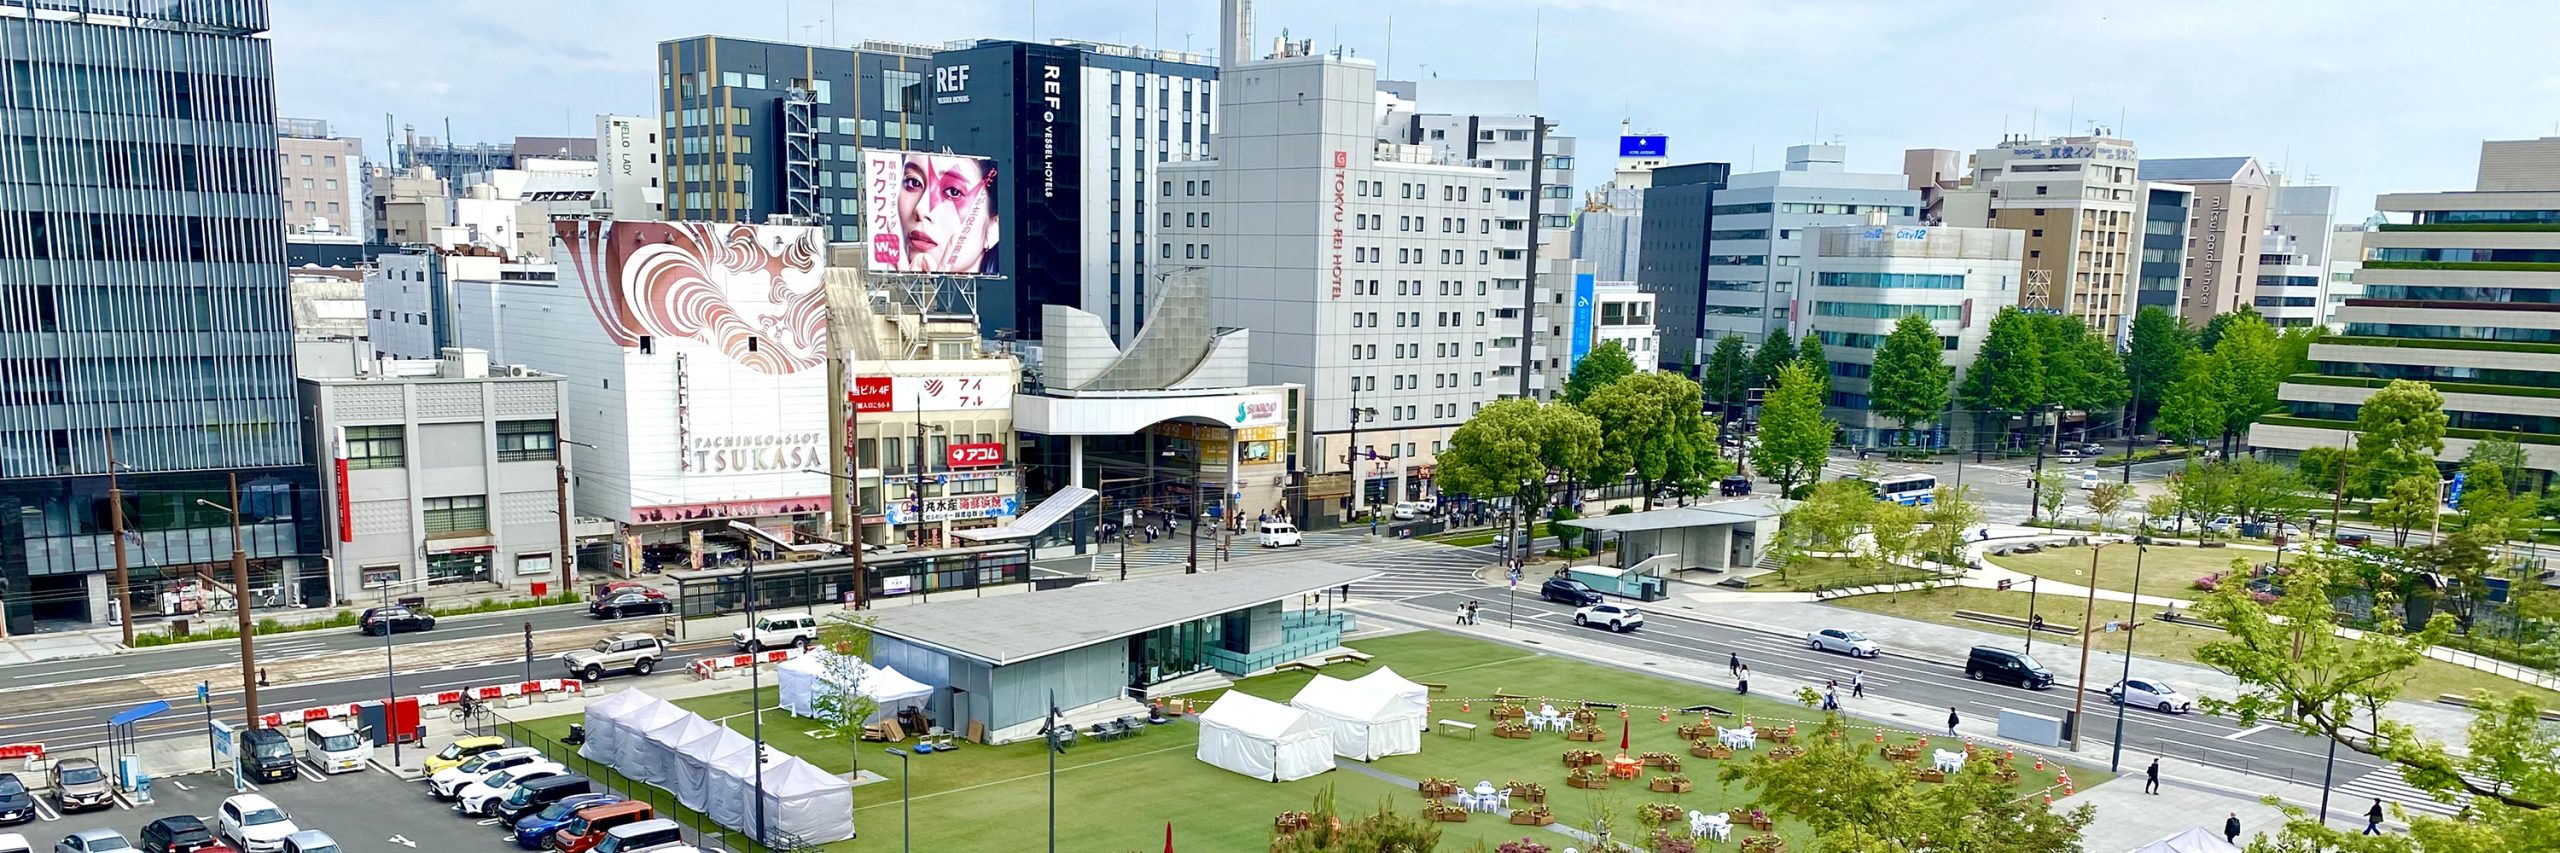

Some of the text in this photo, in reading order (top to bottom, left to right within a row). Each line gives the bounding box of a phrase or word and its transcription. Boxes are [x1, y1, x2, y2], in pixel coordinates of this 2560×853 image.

[936, 64, 970, 93] REF
[1044, 65, 1060, 198] REF VESSEL HOTELS
[621, 121, 632, 176] HELLO LADY
[2050, 146, 2093, 159] 東横イン
[872, 159, 887, 230] ワクワク
[1332, 171, 1345, 301] TOKYU REI HOTEL
[1896, 229, 1926, 240] City12
[2200, 196, 2221, 307] mitsui garden hotel
[694, 446, 822, 473] TSUKASA
[966, 447, 999, 461] アコム
[707, 503, 764, 517] TSUKASA
